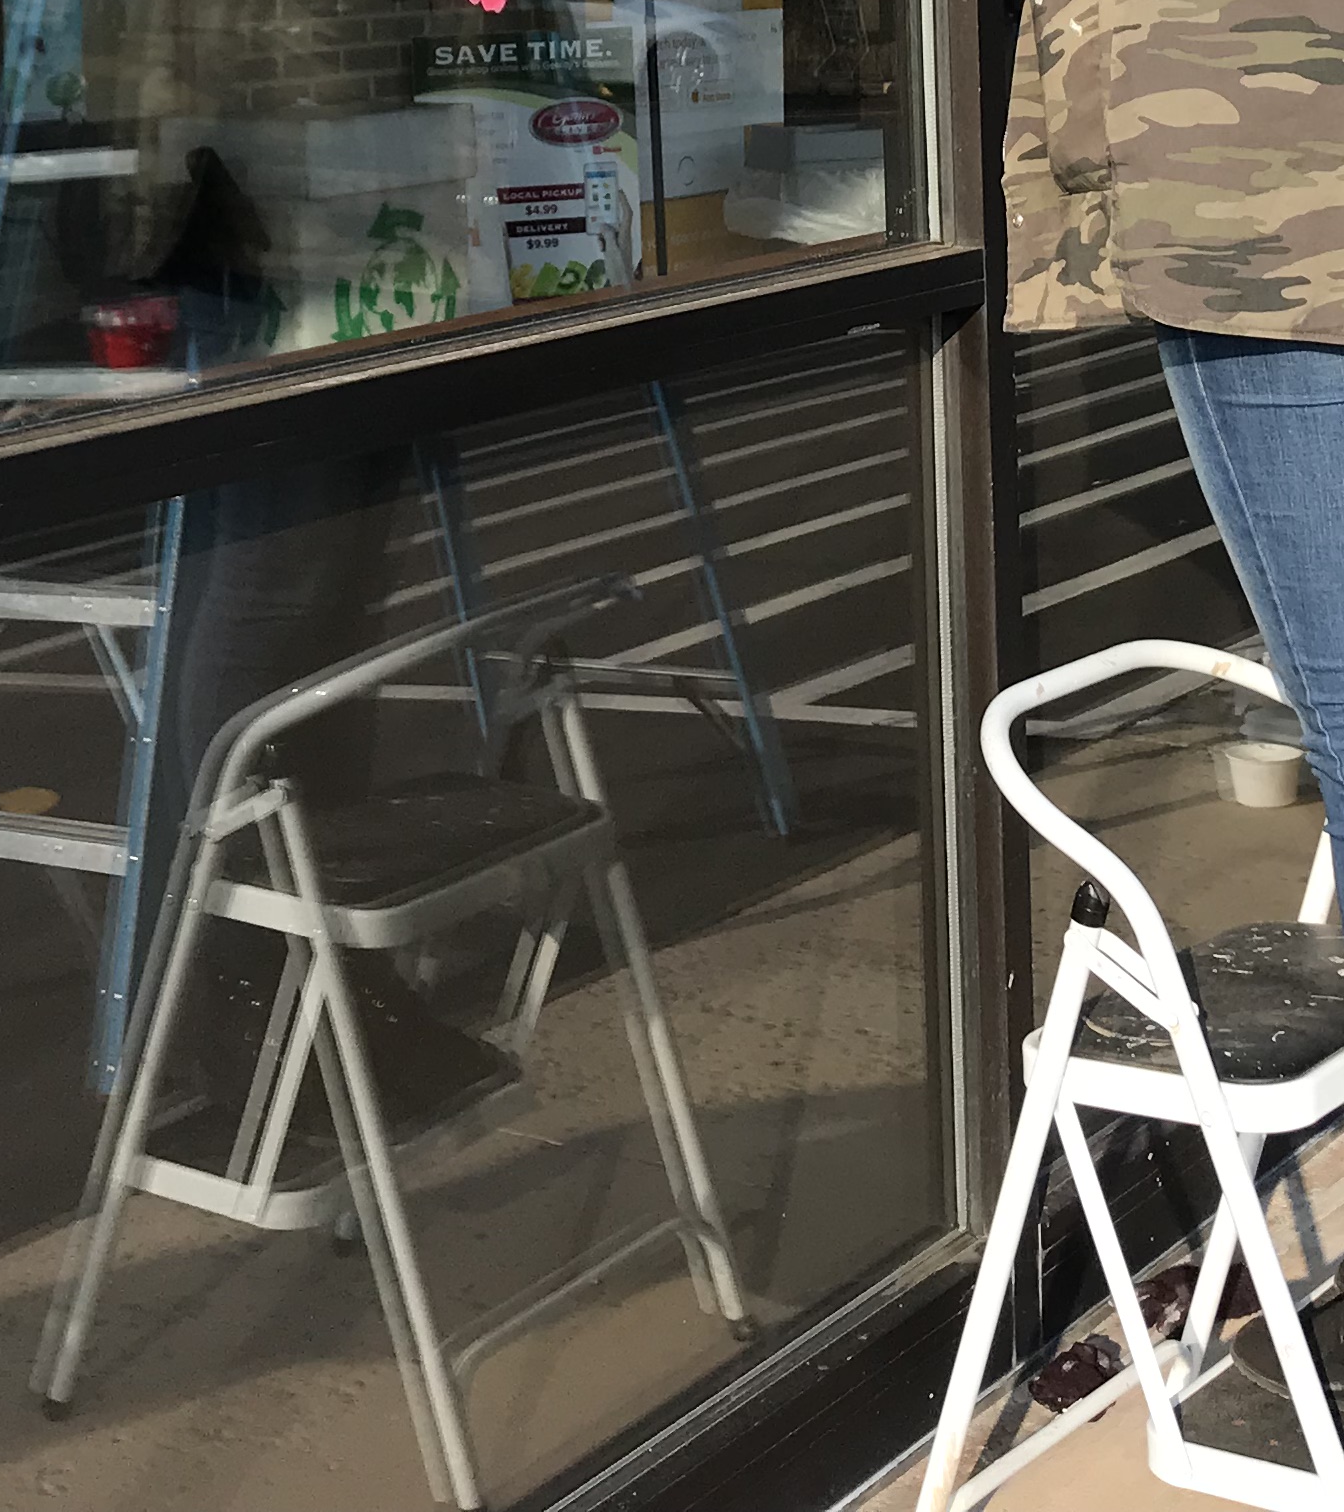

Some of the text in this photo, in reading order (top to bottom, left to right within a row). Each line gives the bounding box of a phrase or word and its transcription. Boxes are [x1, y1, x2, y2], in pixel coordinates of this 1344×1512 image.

[434, 38, 613, 66] SAVE TIME.
[502, 188, 584, 201] LOCAL PICKUP
[525, 203, 559, 216] $4.99
[516, 222, 569, 233] DELIVERY
[526, 237, 560, 250] $9.99
